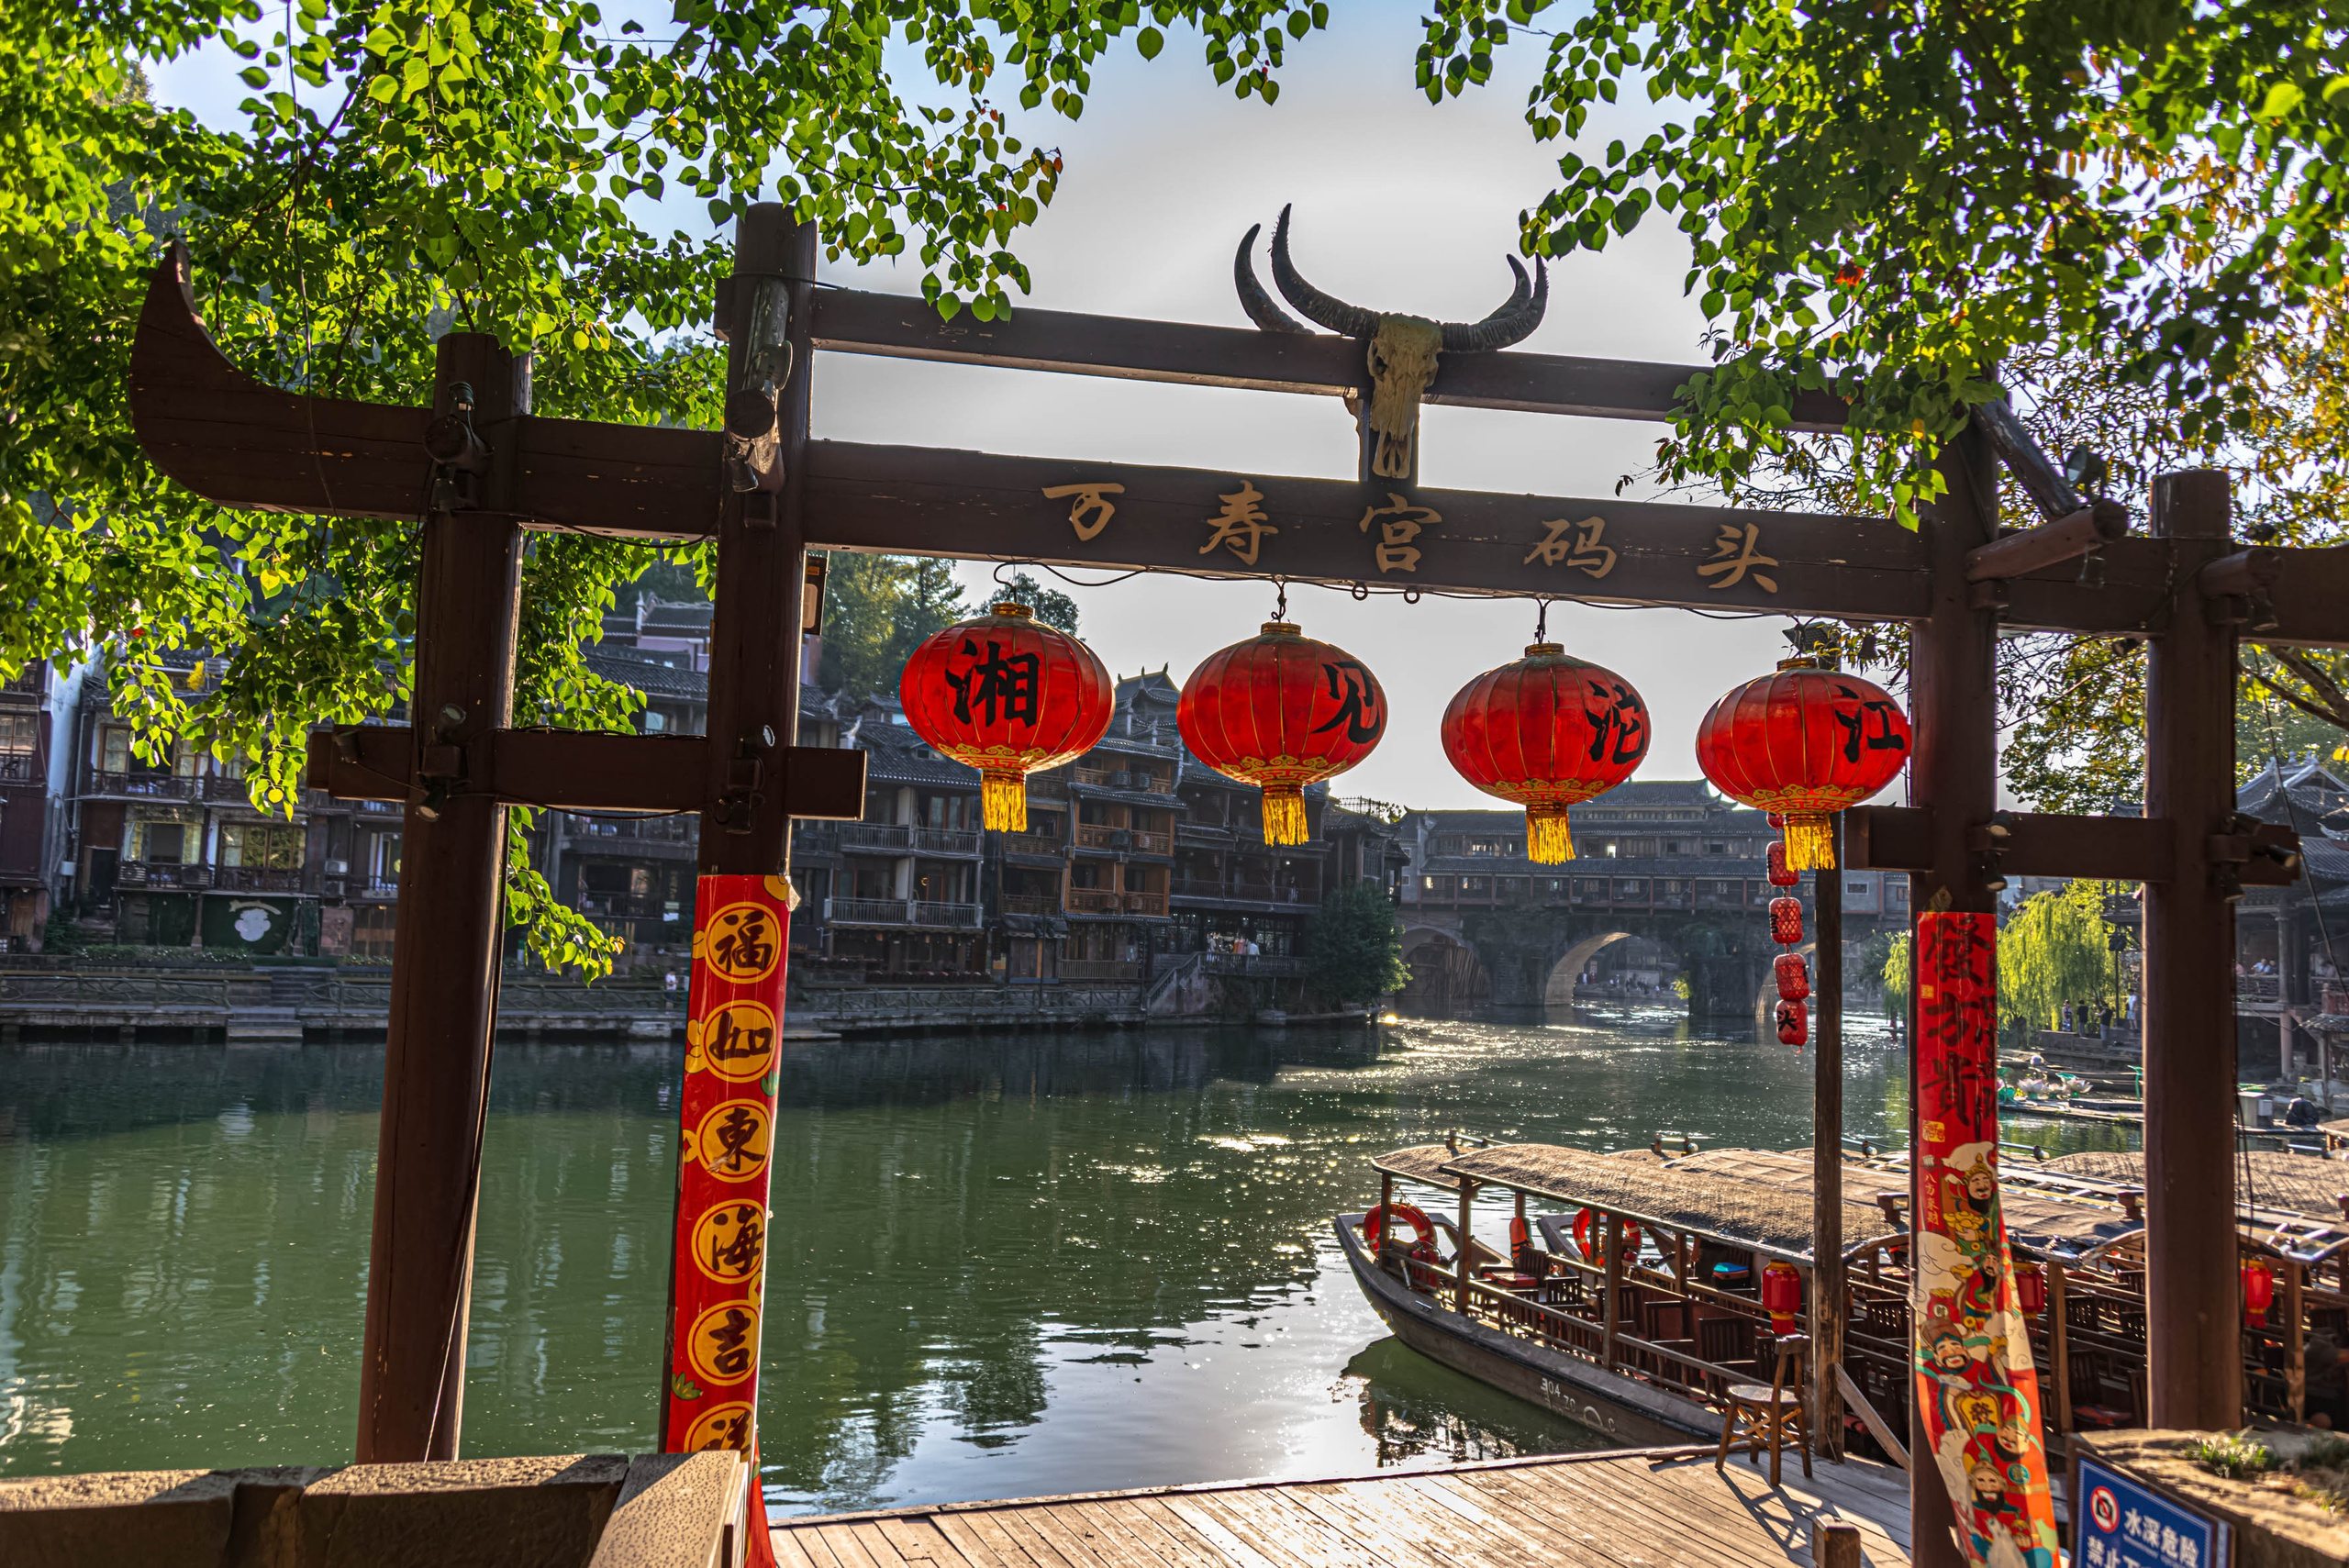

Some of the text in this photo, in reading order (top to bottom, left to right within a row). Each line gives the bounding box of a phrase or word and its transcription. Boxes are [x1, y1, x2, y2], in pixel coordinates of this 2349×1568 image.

[1041, 479, 1779, 594] 万寿宫码头
[945, 639, 1040, 728] 湘
[1312, 662, 1381, 743] 见
[1585, 680, 1648, 765] 沱
[1834, 684, 1906, 764] 江
[1777, 1010, 1798, 1031] 头
[2087, 1535, 2151, 1568] 禁止
[2123, 1507, 2199, 1568] 水深危险
